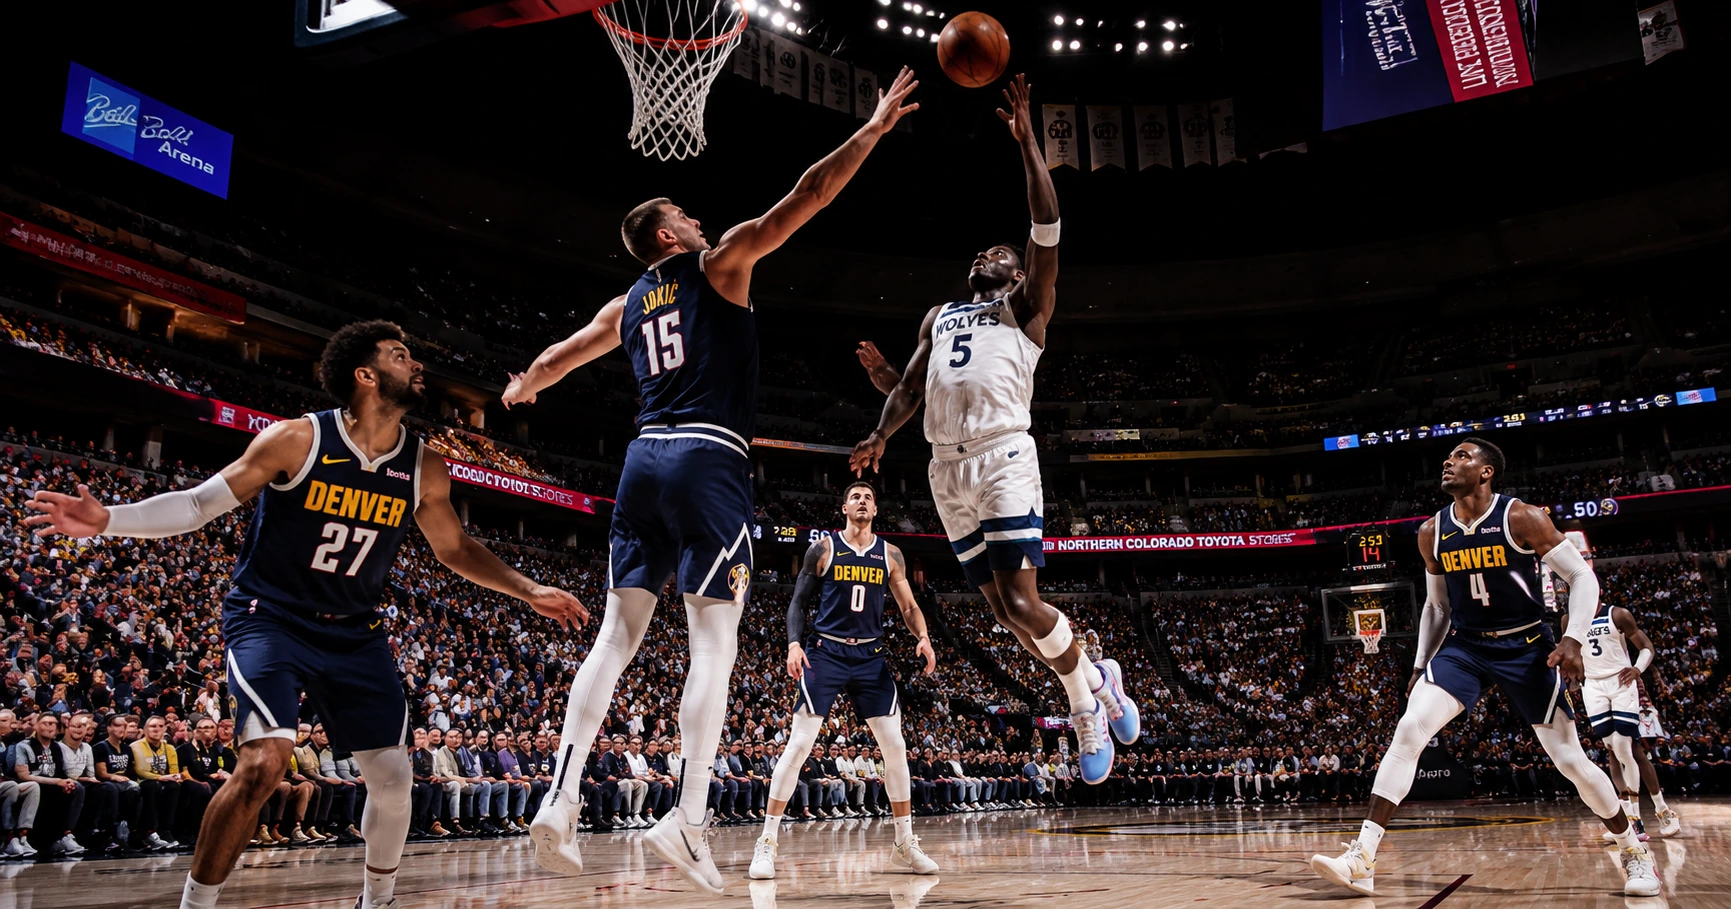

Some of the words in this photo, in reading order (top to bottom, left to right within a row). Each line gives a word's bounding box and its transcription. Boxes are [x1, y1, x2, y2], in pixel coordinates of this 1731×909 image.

[158, 141, 214, 175] Arena
[936, 311, 1000, 339] WOLVES
[641, 310, 685, 376] 15
[948, 332, 973, 369] 5
[303, 480, 407, 528] DENVER
[1574, 501, 1598, 517] 50
[310, 521, 379, 577] 27
[1058, 539, 1123, 551] NORTHERN
[1126, 537, 1195, 549] COLORADO
[1197, 536, 1246, 548] TOYOTA
[1362, 546, 1380, 563] 14
[1441, 545, 1508, 573] DENVER
[834, 565, 884, 585] DENVER
[850, 584, 866, 613] 0
[1469, 572, 1490, 607] 4
[1588, 638, 1603, 657] 3
